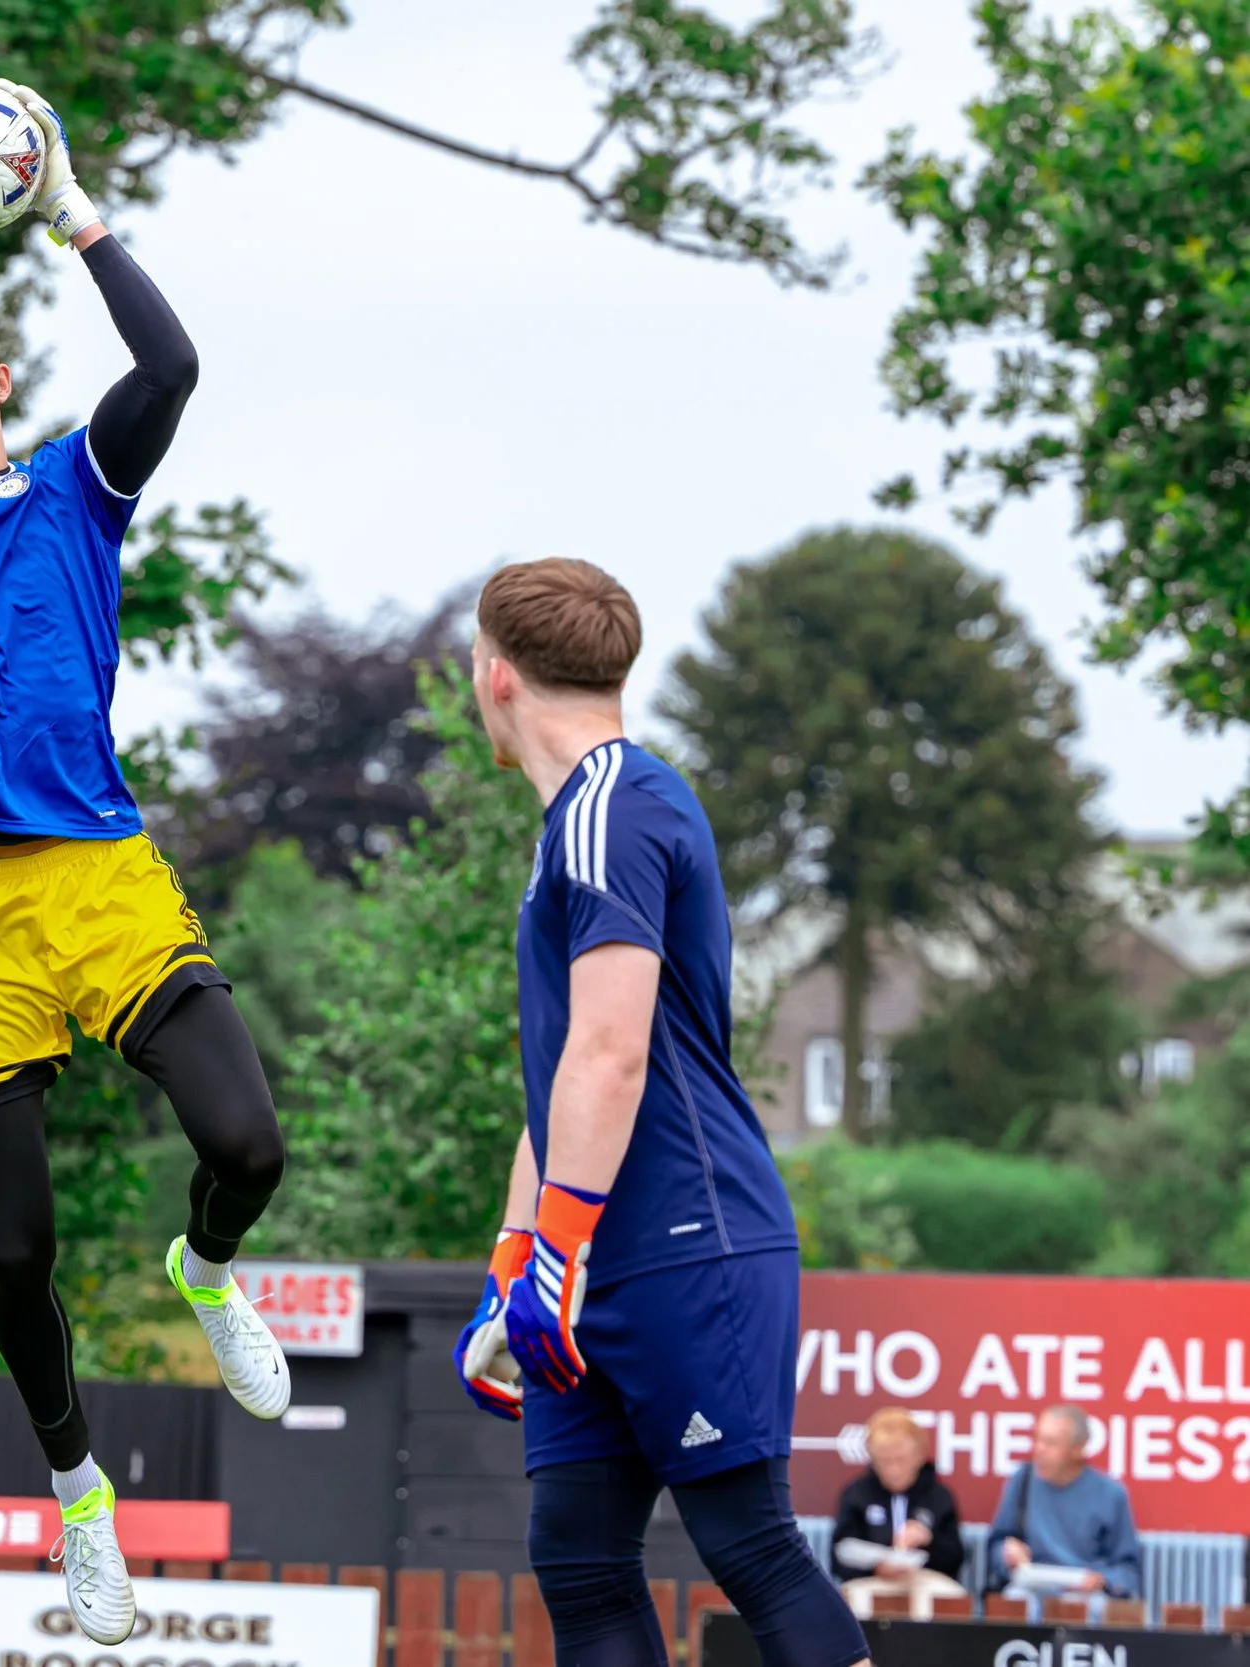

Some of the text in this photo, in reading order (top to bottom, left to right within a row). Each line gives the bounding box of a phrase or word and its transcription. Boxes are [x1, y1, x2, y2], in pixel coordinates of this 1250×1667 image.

[960, 1333, 1104, 1400] ATE
[1125, 1336, 1250, 1403] ALL
[34, 1604, 274, 1645] GRGE
